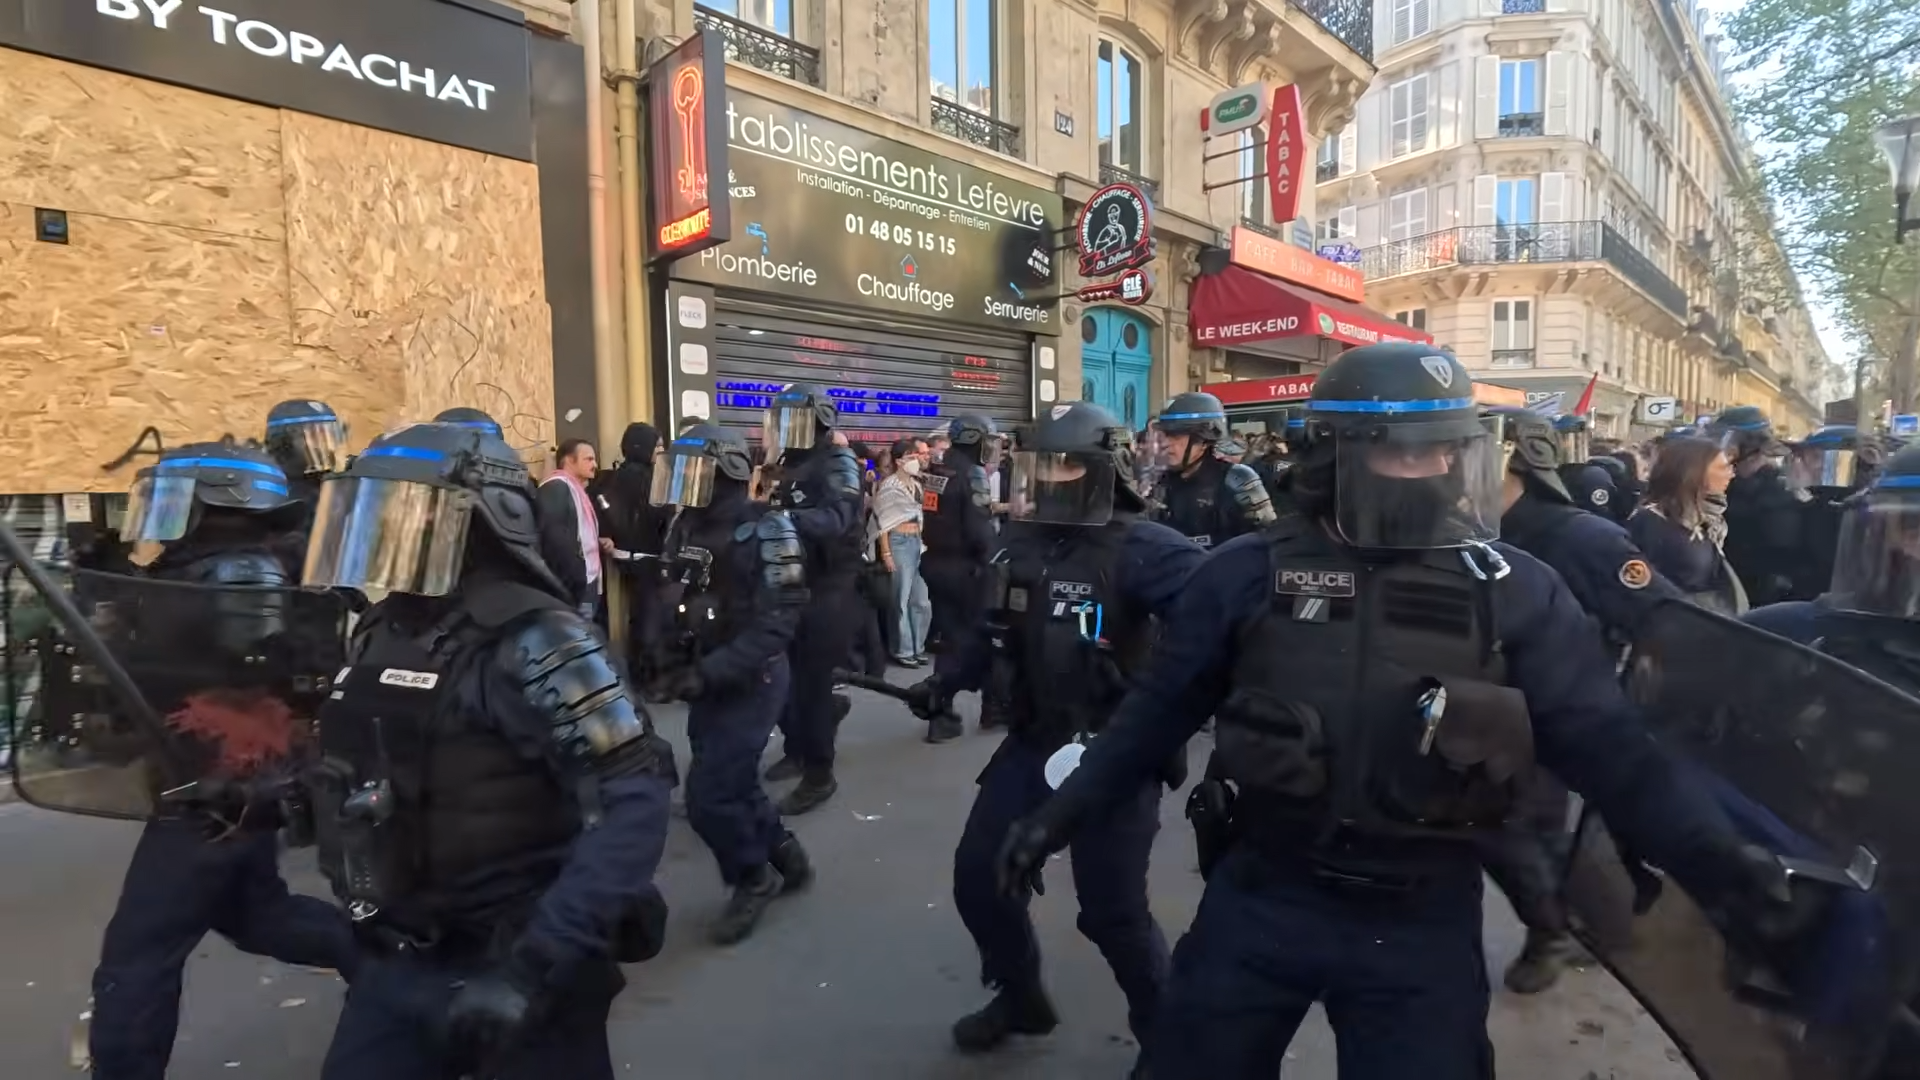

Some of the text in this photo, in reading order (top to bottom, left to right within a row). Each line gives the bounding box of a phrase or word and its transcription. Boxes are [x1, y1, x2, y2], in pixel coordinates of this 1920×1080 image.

[96, 0, 495, 110] BY TOPACHAT
[1057, 114, 1071, 135] 124
[726, 101, 1044, 225] tablissements Lefevre
[1277, 112, 1290, 194] TABAC
[797, 168, 990, 231] Installation Dépannage Entretien
[1092, 189, 1131, 208] CHAUFFAGE
[845, 213, 956, 255] 01 48 05 15 15
[1034, 260, 1050, 276] NUIT
[1291, 258, 1314, 276] BAR
[1326, 269, 1356, 291] TABAC
[701, 246, 1048, 323] Plomberie Chauffage Serrurerie
[1123, 273, 1142, 291] CLÉ
[1197, 316, 1299, 340] LE WEEK-END
[1336, 321, 1378, 343] RESTAURANT
[1281, 571, 1350, 587] POLICE
[386, 673, 431, 685] POLICE
